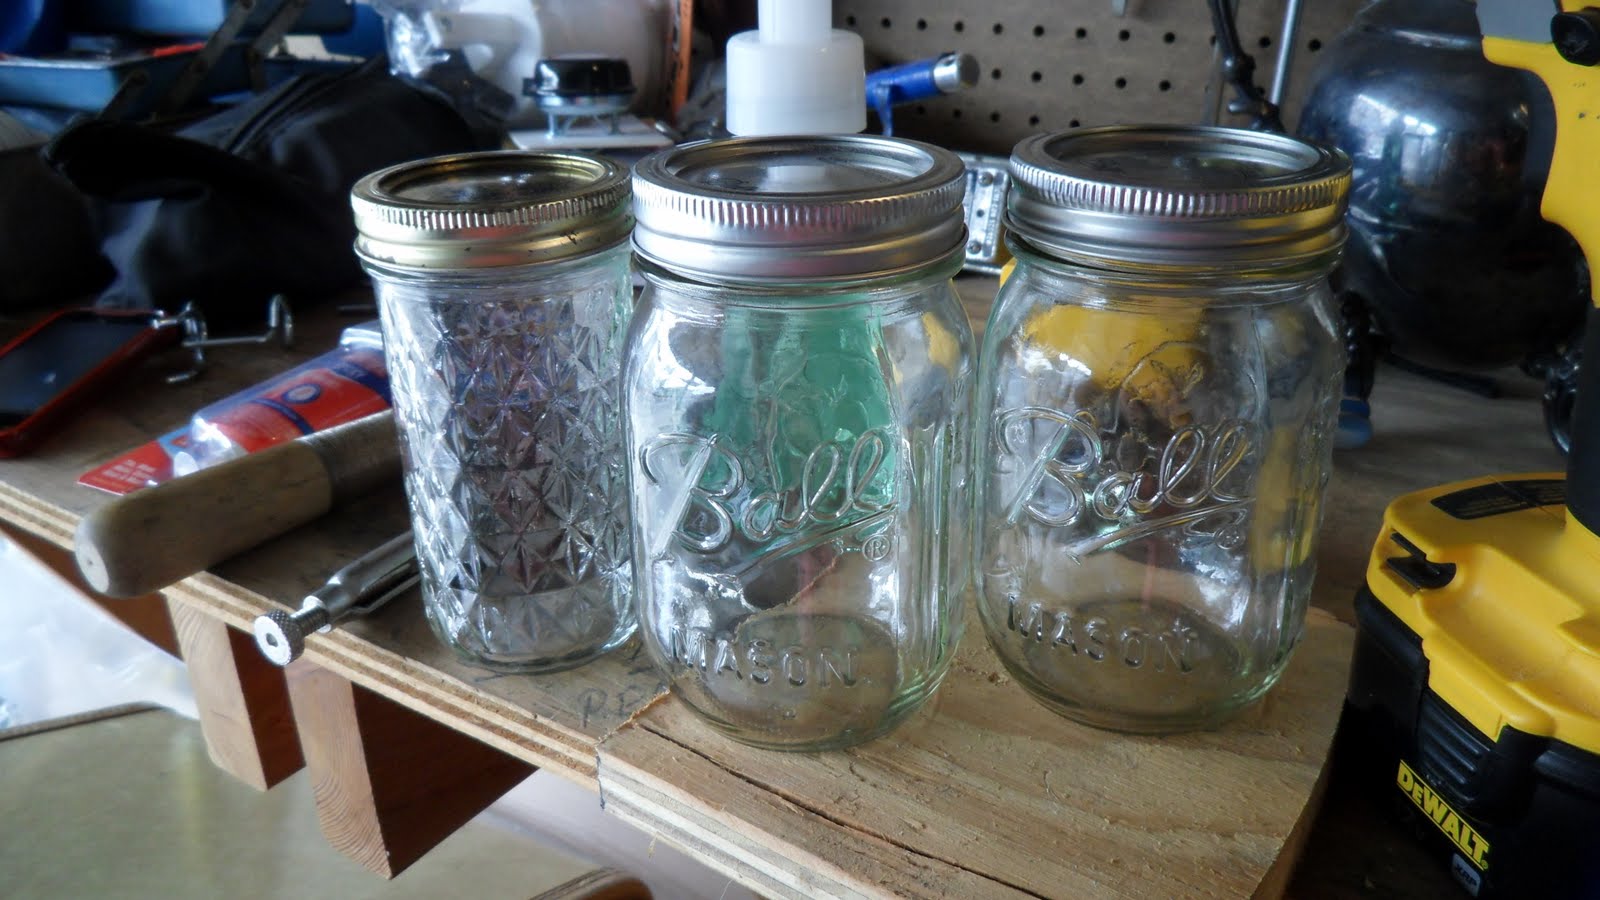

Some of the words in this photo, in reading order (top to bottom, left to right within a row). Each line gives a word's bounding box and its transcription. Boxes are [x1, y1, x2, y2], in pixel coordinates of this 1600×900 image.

[639, 428, 898, 556] Ball
[994, 405, 1257, 528] Ball
[669, 626, 858, 688] MASON
[1006, 593, 1200, 673] MASON
[1397, 761, 1489, 864] DEWALT
